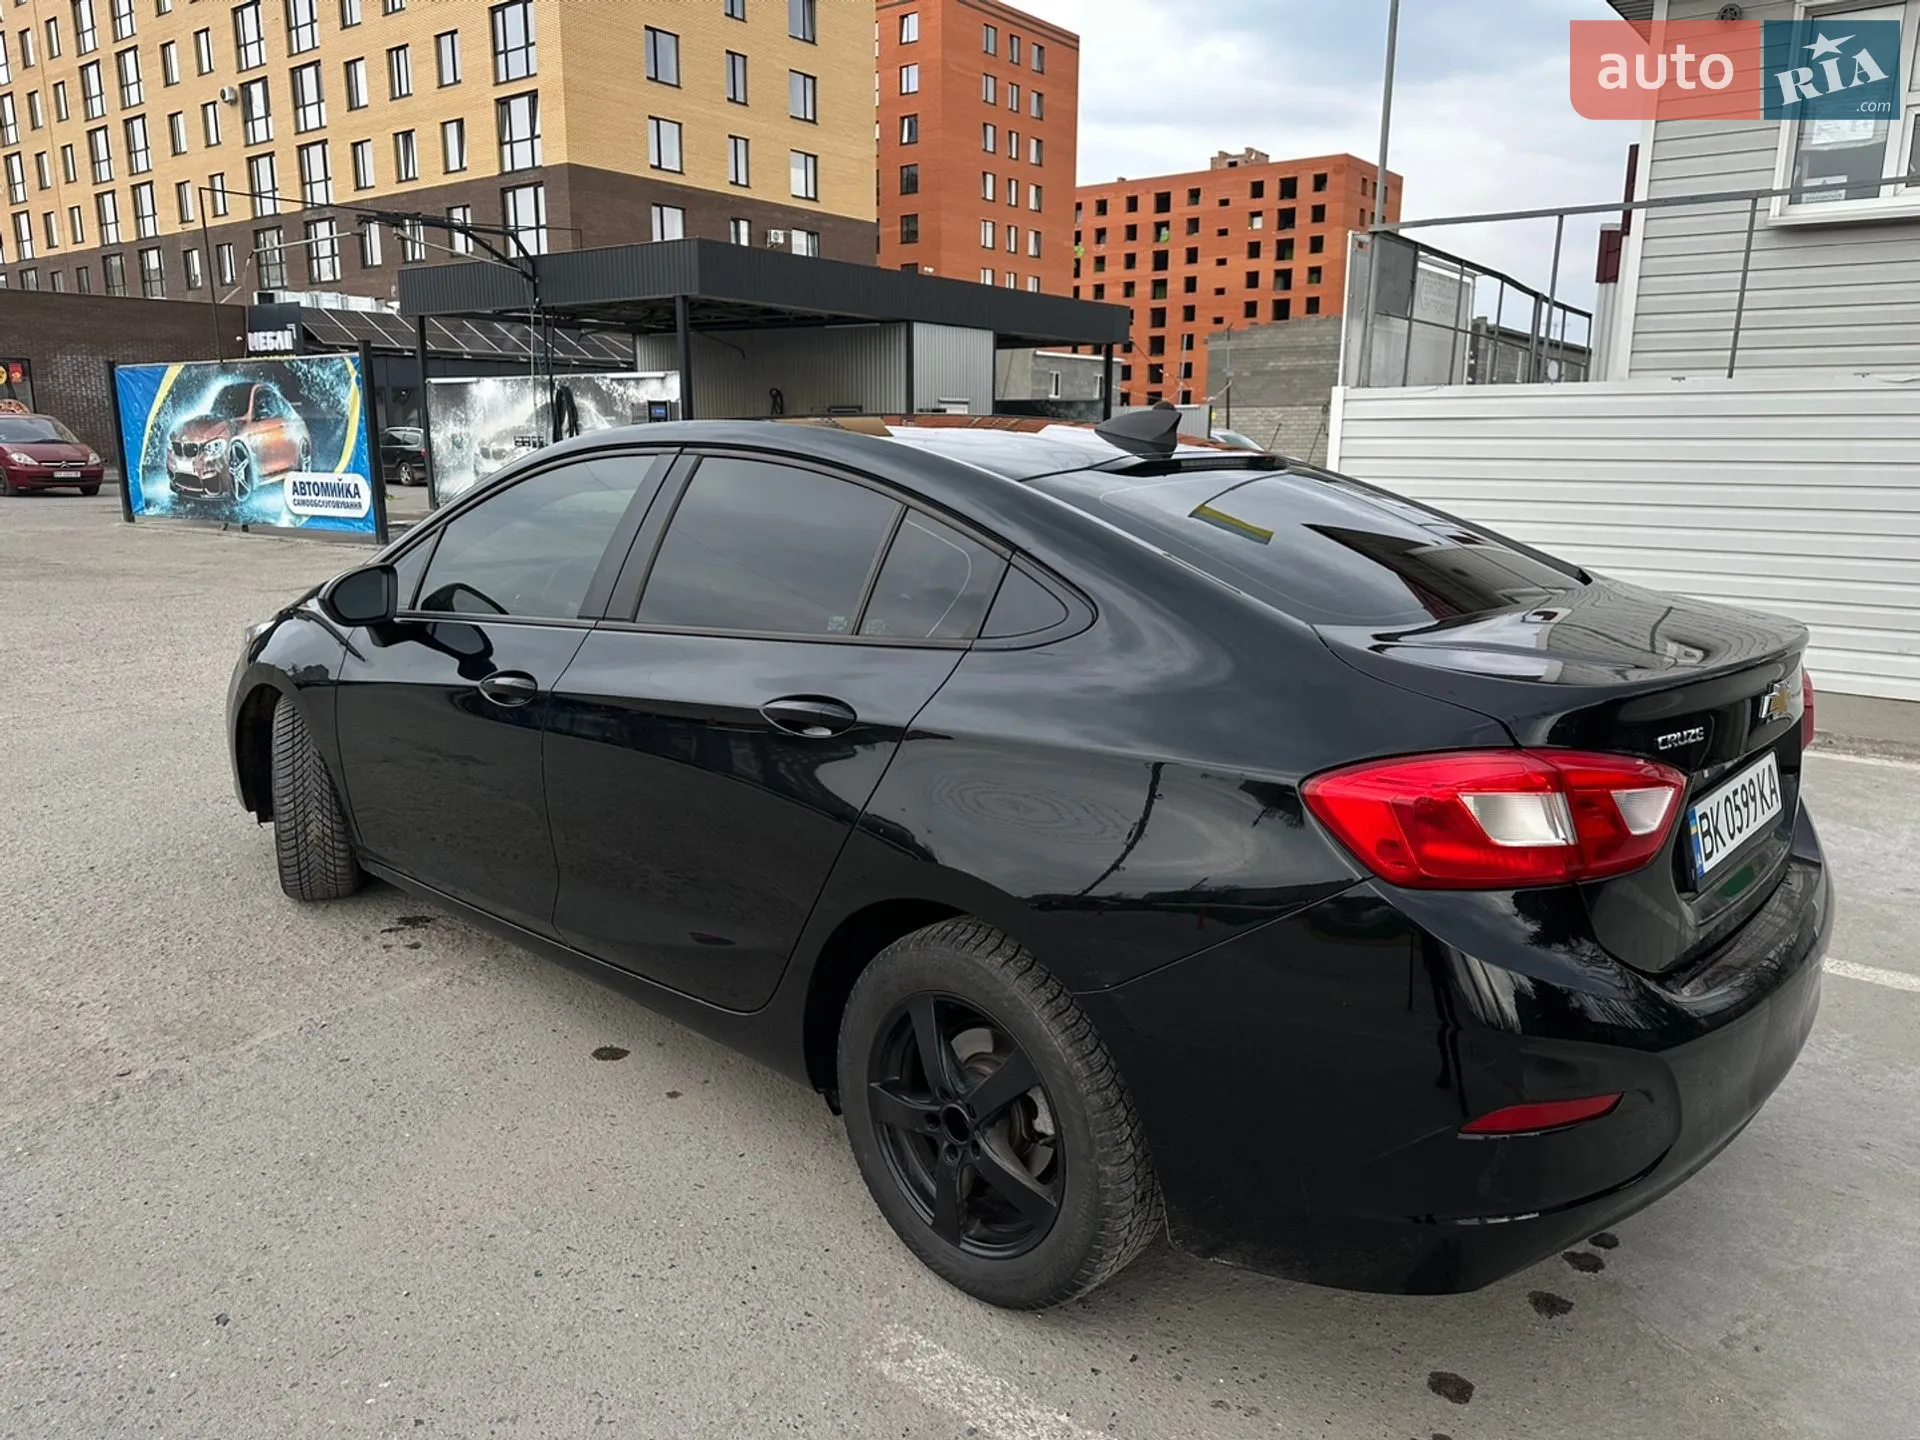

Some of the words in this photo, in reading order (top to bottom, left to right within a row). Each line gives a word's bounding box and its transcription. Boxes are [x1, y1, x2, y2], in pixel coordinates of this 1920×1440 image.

[292, 477, 361, 499] АВТОМИЙКА
[1657, 726, 1705, 750] CRUZE
[1698, 801, 1726, 862] BK
[1724, 778, 1757, 841] 0599
[1757, 764, 1779, 816] KA
